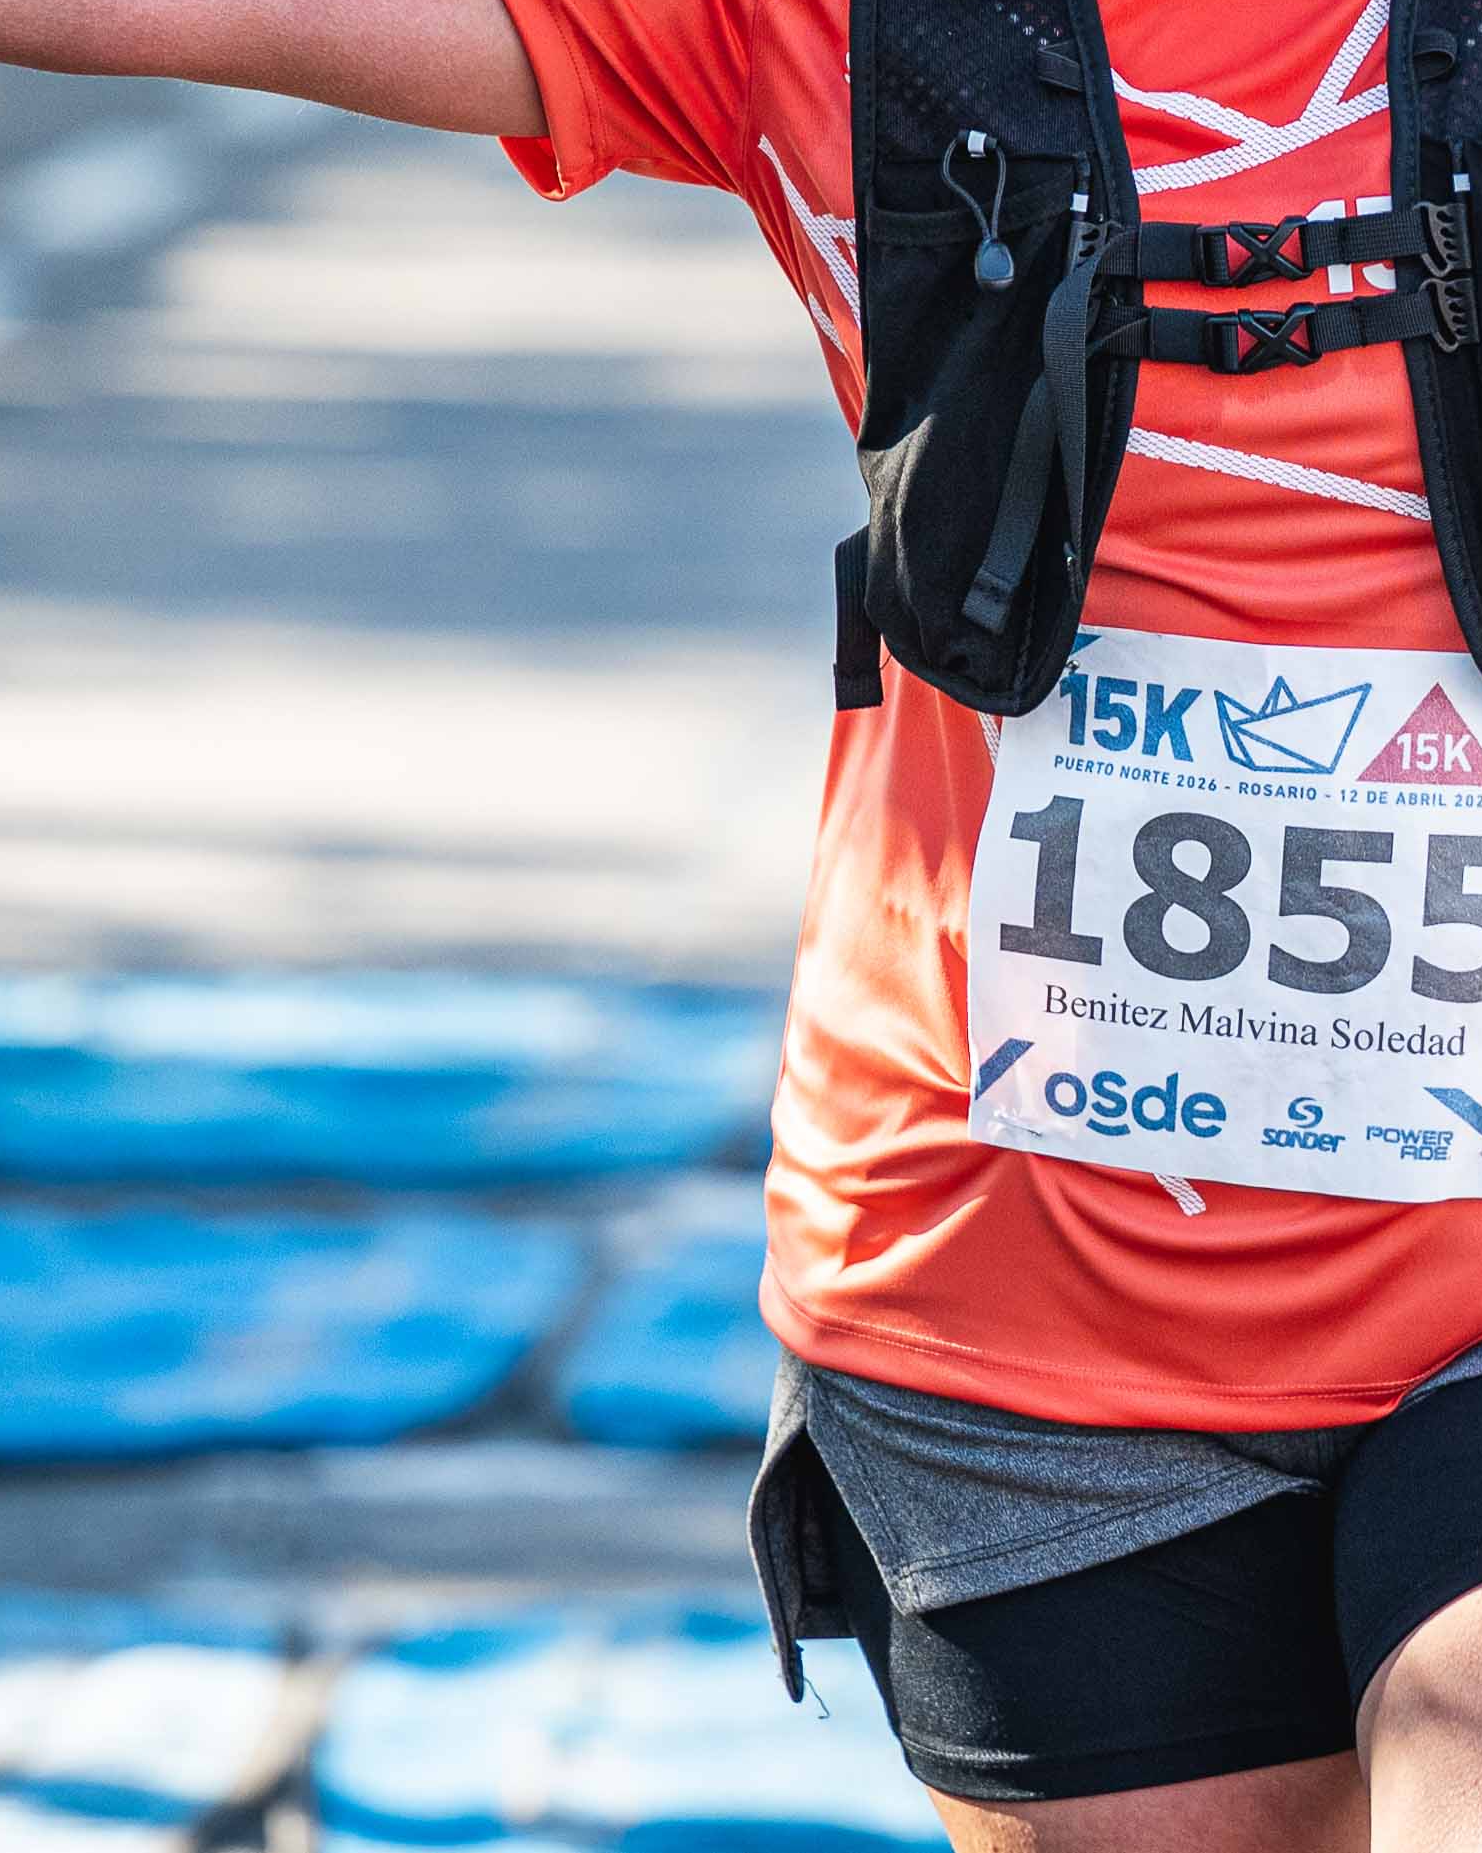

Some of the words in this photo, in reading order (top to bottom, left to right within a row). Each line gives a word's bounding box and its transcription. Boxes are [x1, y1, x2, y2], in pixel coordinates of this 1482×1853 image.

[1059, 673, 1203, 762] 15K
[1396, 732, 1472, 772] 15K
[1054, 755, 1114, 776] PUERTO
[1120, 766, 1169, 785] NORTE
[1176, 774, 1217, 792] 2026
[1238, 781, 1317, 801] ROSARIO
[1340, 789, 1358, 803] 12
[1367, 791, 1388, 805] DE
[1395, 791, 1446, 807] ABRIL
[1044, 984, 1168, 1031] Benitez
[1178, 1003, 1319, 1047] Malvina
[1330, 1019, 1466, 1057] Soledad
[1044, 1070, 1227, 1138] osde
[1366, 1125, 1454, 1145] POWER
[1400, 1144, 1449, 1161] ADE
